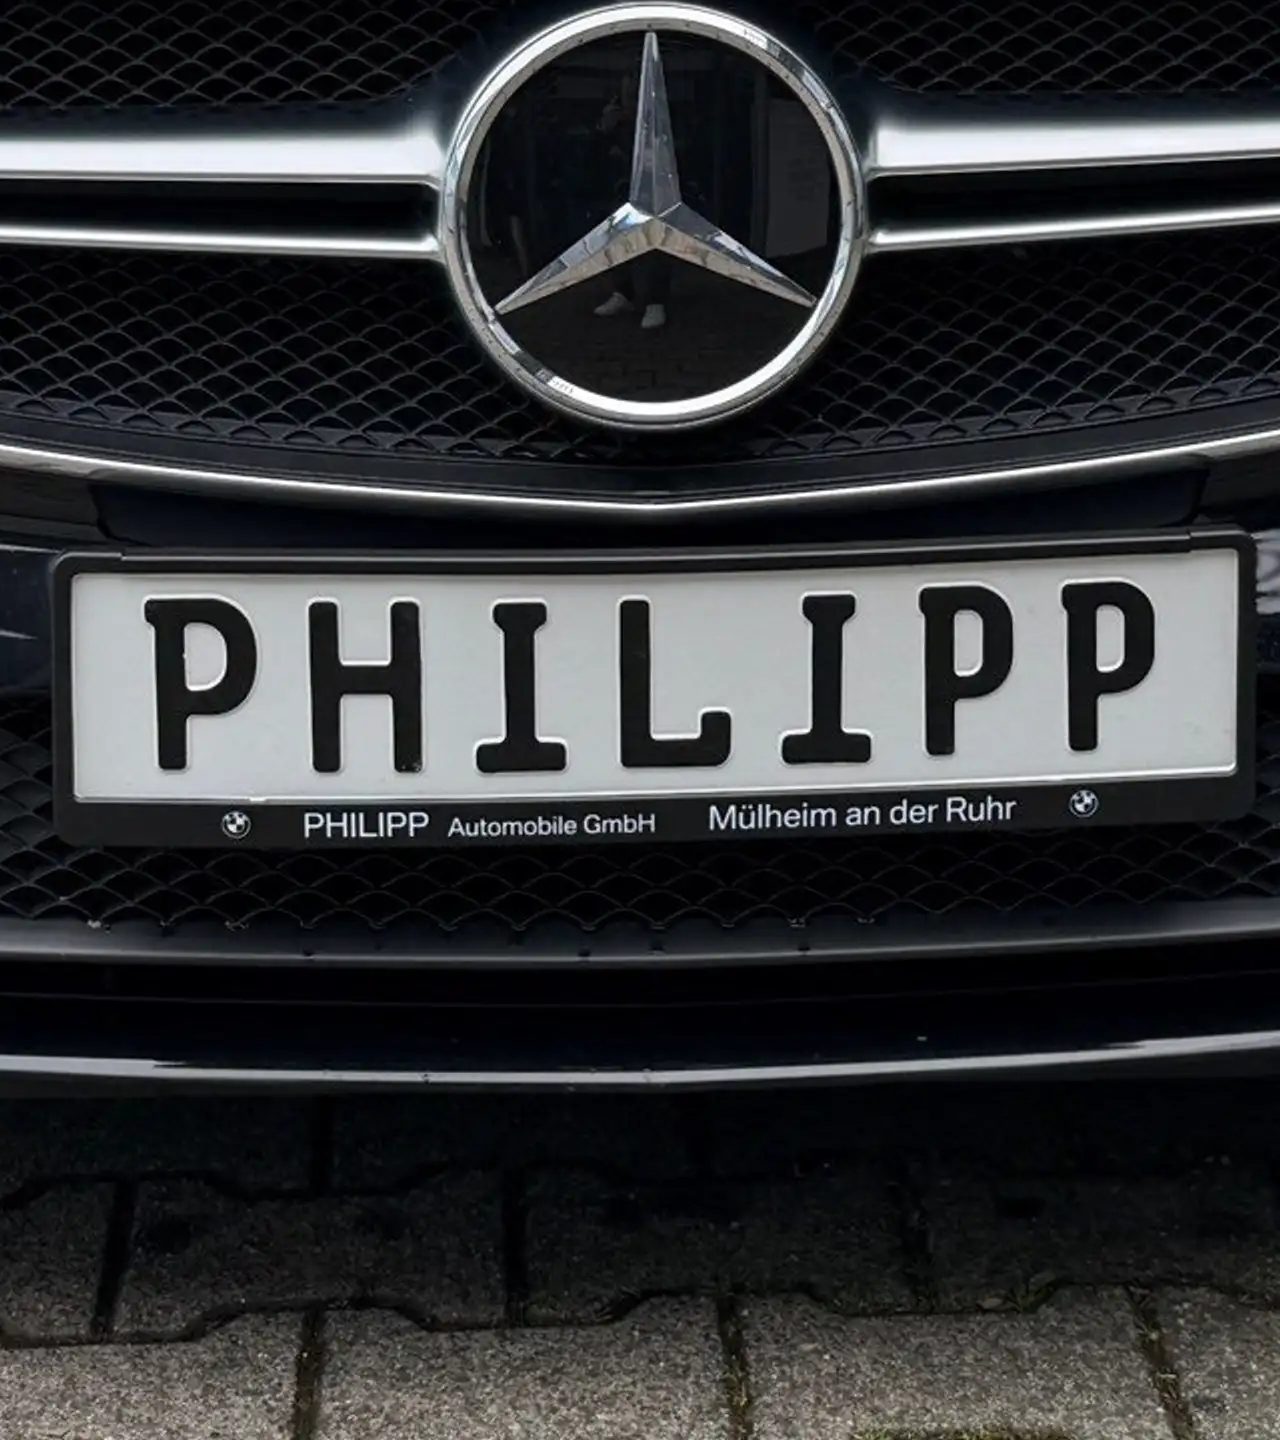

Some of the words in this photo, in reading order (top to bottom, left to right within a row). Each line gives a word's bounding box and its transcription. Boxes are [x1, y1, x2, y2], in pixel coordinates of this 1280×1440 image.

[143, 581, 1156, 774] PHILIPP
[303, 811, 430, 838] PHILIPP
[447, 814, 578, 838] Automobile
[583, 813, 656, 835] GmbH
[708, 802, 838, 831] Mülheim
[845, 806, 881, 827] an
[889, 798, 940, 826] der
[945, 794, 1018, 823] Ruhr
